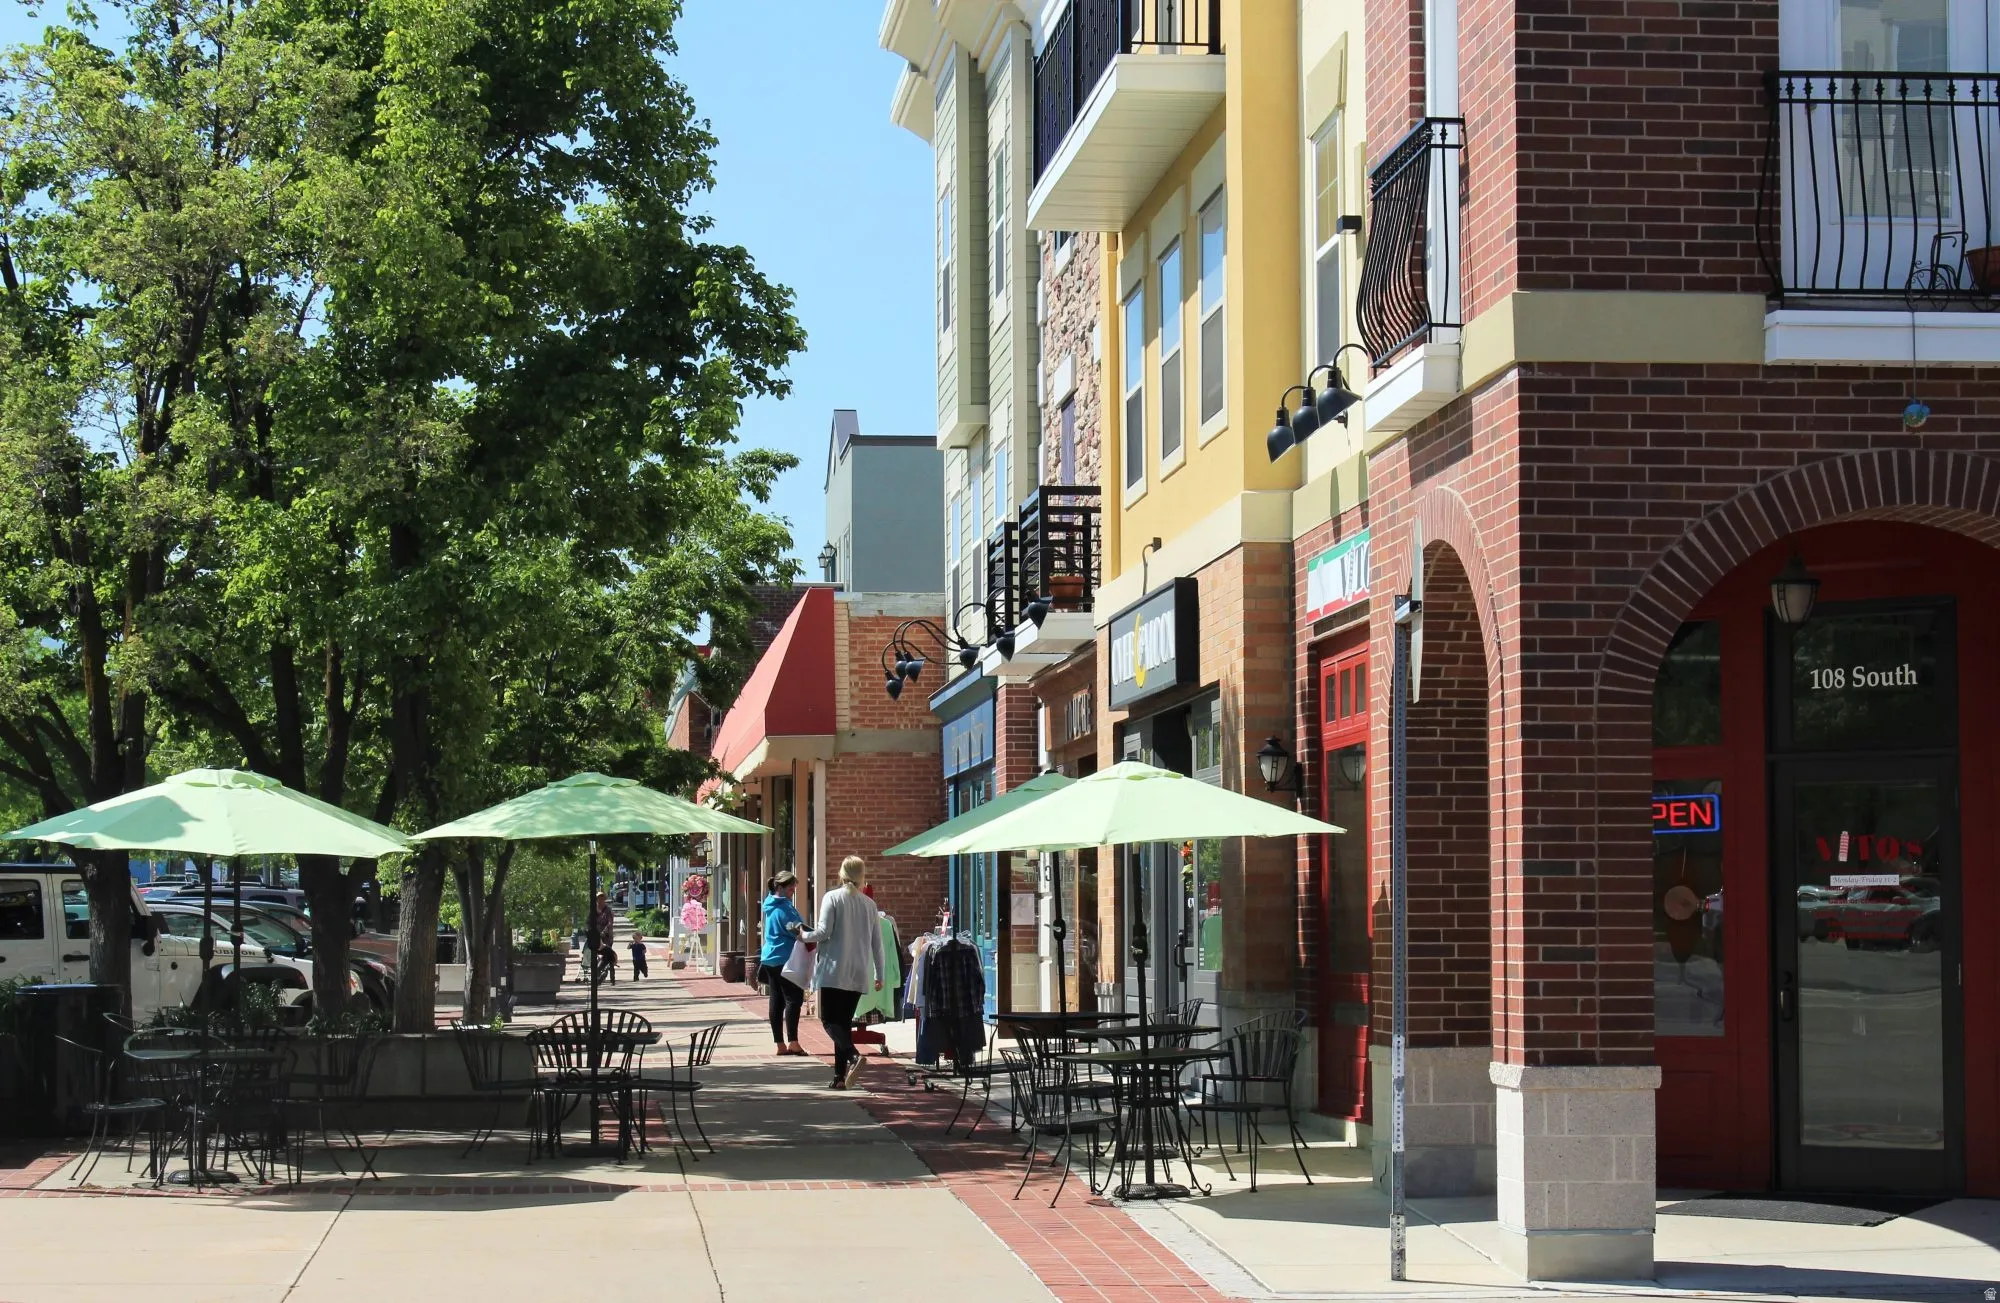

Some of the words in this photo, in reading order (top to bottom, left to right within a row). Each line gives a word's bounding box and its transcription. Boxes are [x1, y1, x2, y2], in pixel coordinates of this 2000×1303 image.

[1810, 667, 1846, 690] 108
[1852, 663, 1918, 688] South
[1652, 802, 1712, 826] PEN
